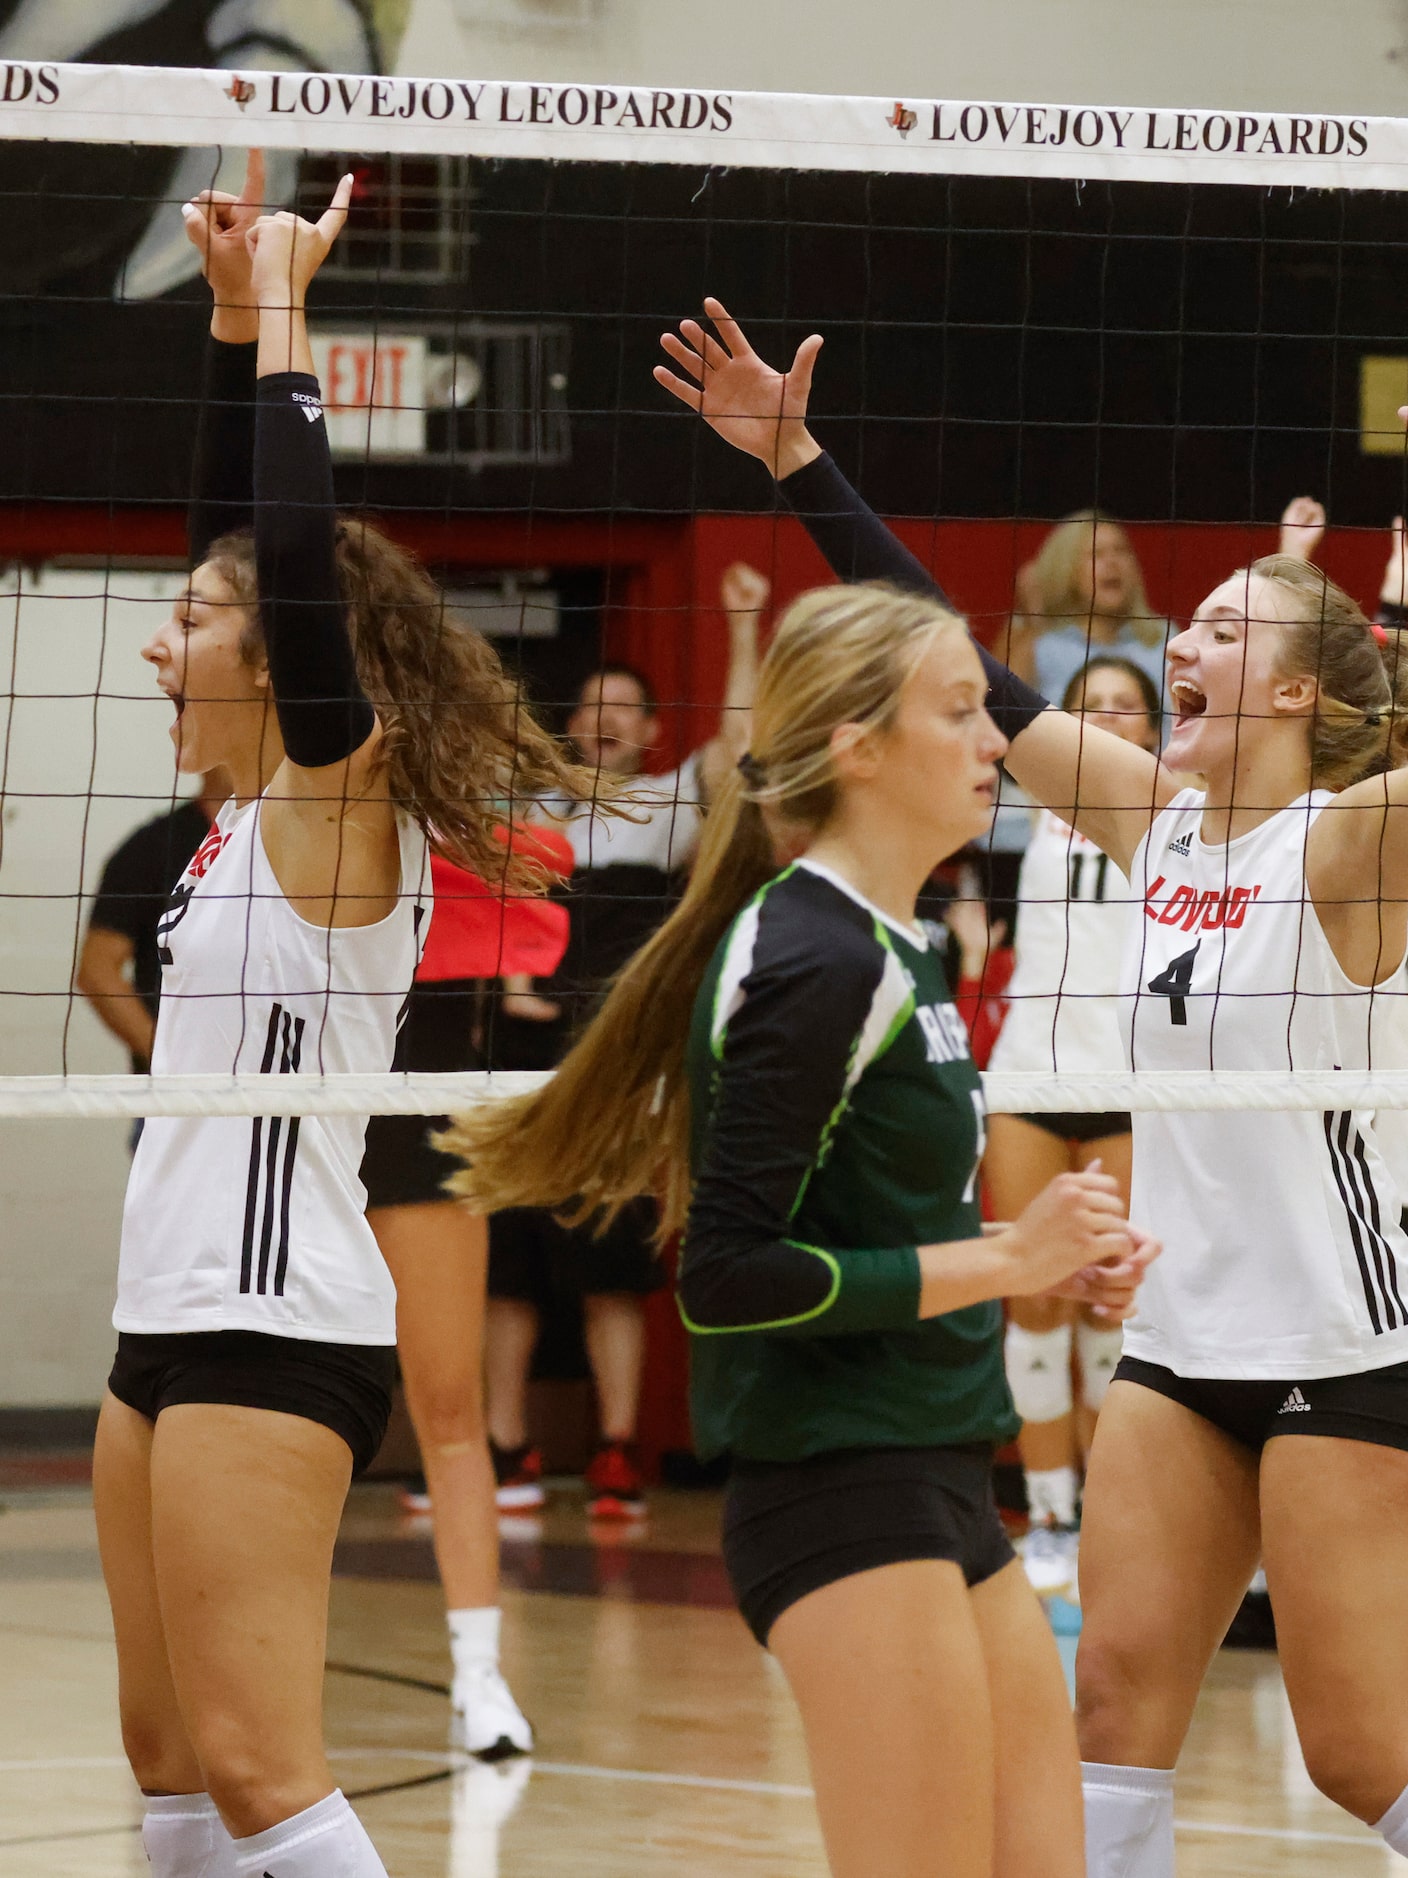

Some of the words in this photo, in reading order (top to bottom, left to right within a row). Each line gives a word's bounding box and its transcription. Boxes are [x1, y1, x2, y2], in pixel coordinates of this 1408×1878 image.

[268, 76, 486, 121] LOVEJOY
[498, 86, 733, 132] LEOPARDS
[929, 104, 1135, 149] LOVEJOY
[1144, 113, 1369, 157] LEOPARDS
[327, 345, 406, 415] EXIT
[1168, 843, 1190, 857] adidas
[1069, 852, 1108, 903] 11
[1147, 937, 1202, 1026] 4
